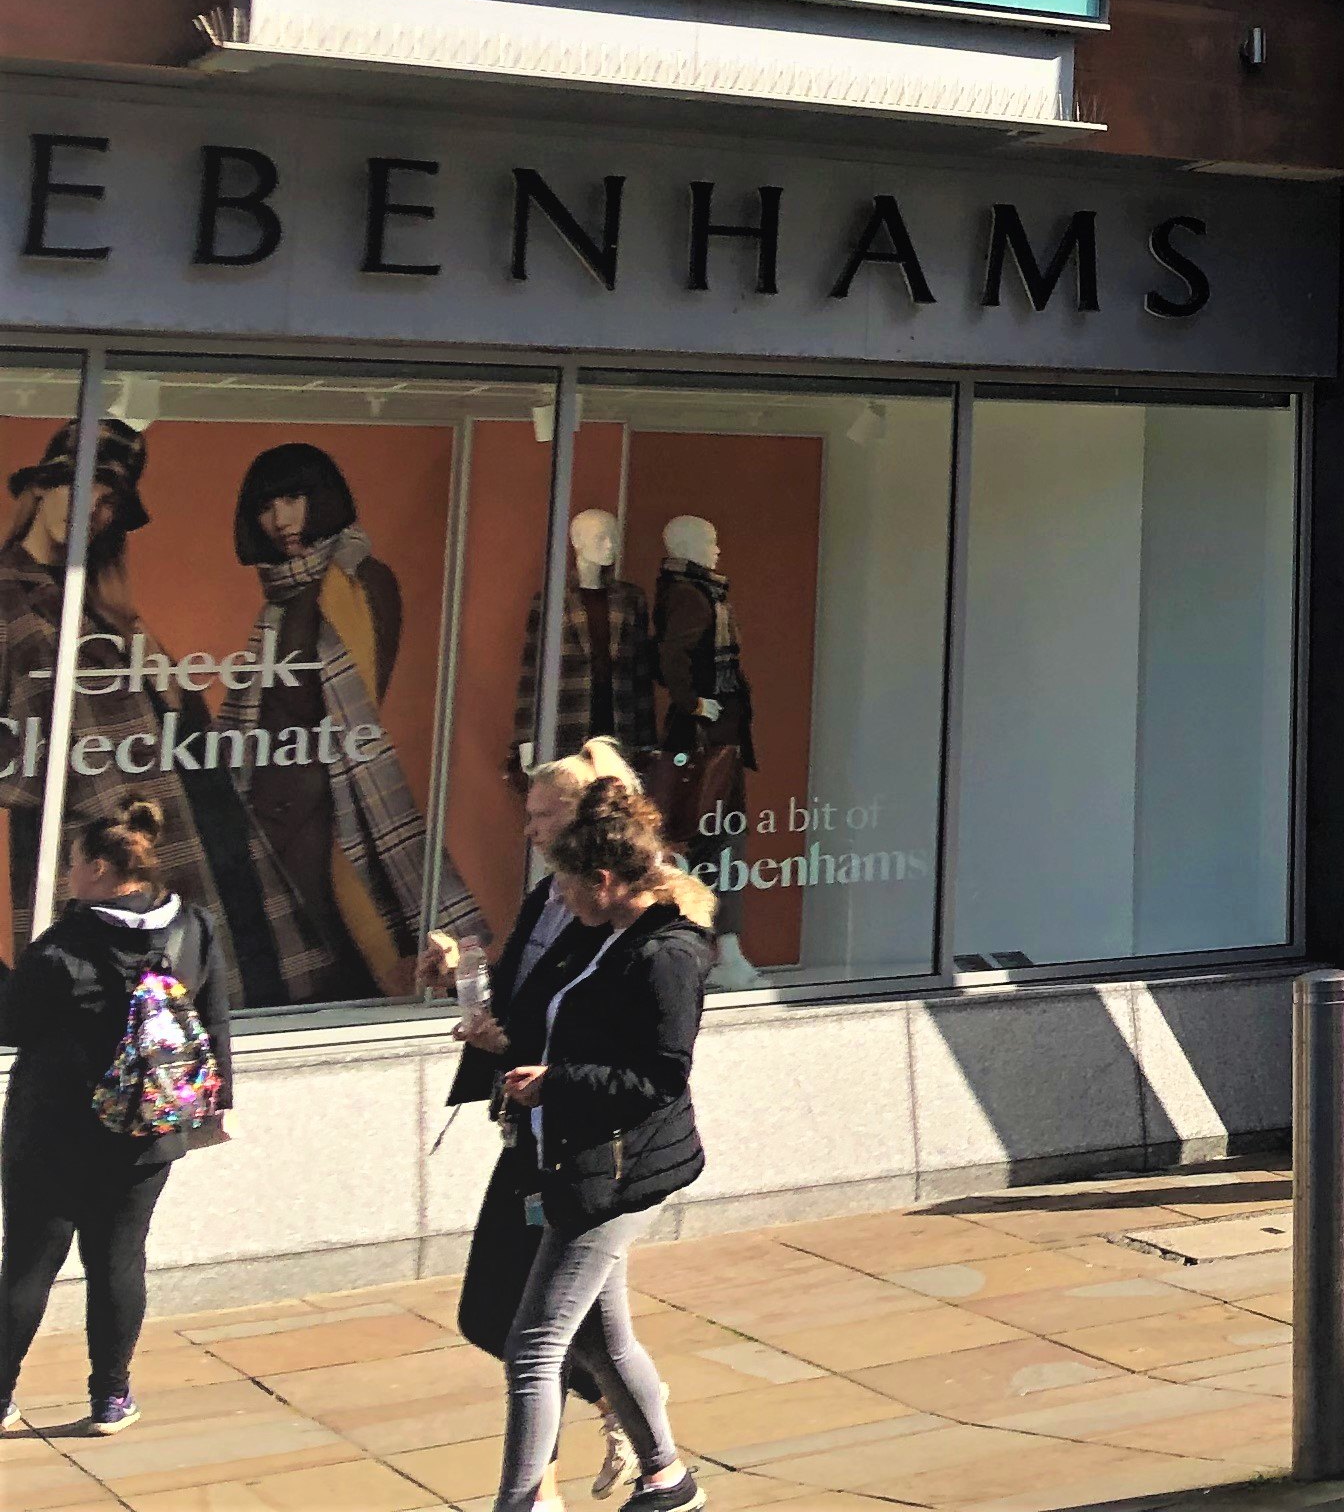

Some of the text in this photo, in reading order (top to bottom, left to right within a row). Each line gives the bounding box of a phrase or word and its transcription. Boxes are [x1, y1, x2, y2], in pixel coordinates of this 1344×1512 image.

[20, 132, 1211, 319] EBENHAMS
[73, 628, 303, 696] Check
[698, 797, 884, 836] do a bit of
